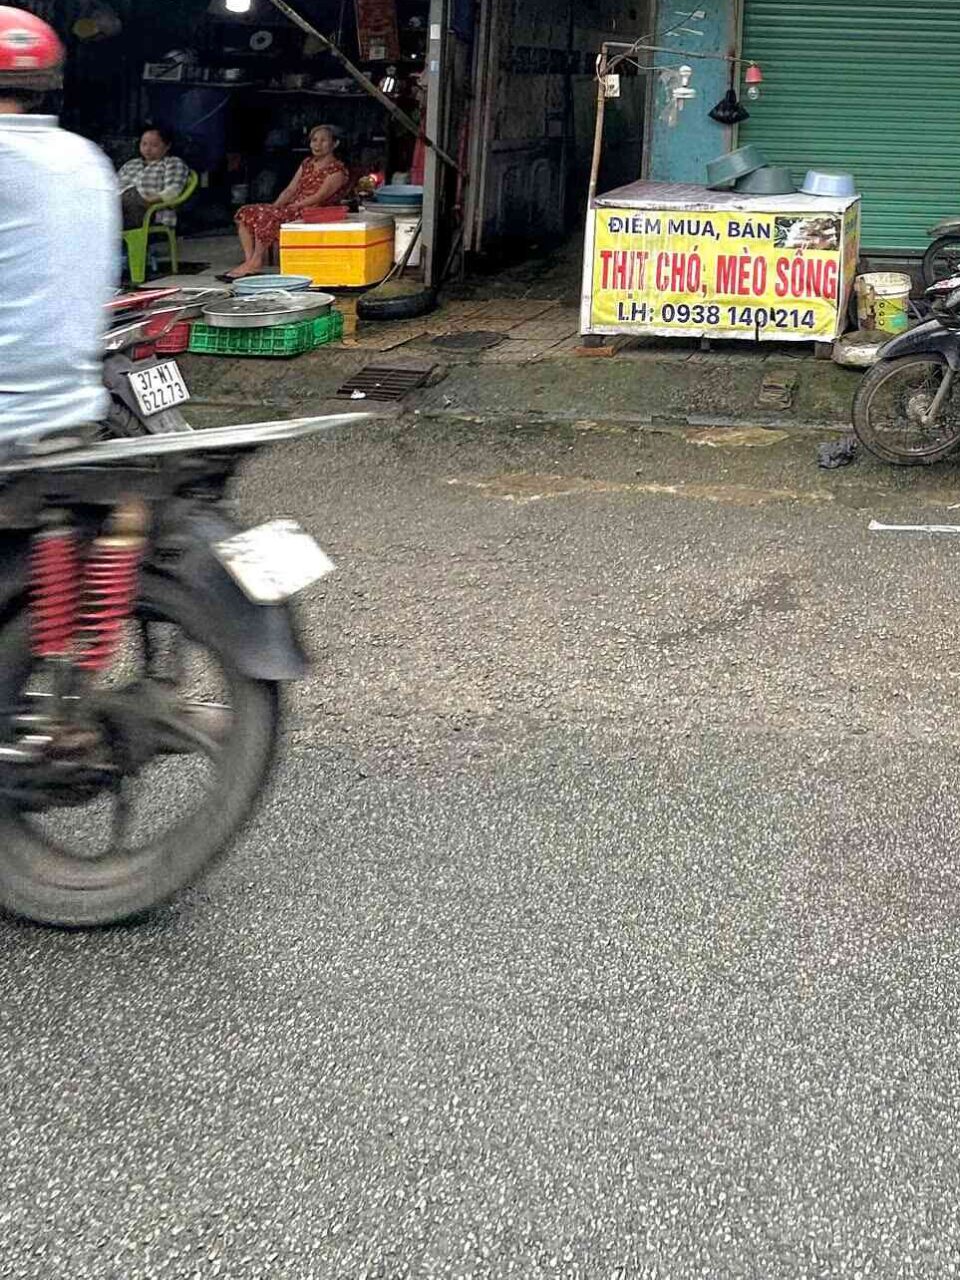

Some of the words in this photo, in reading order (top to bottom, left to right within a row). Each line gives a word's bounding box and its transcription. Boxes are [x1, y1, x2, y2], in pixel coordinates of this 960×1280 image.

[608, 211, 661, 235] ĐIỂM
[668, 219, 720, 240] MUA,
[727, 218, 771, 239] BÁN
[600, 250, 649, 299] THỊT
[655, 245, 707, 298] CHÓ,
[716, 247, 768, 297] MÈO
[775, 241, 837, 300] SỐNG
[618, 302, 654, 322] LH:
[661, 303, 720, 325] 0938
[728, 306, 768, 328] 140
[775, 308, 815, 329] 214
[137, 365, 173, 390] 37-N1
[142, 382, 184, 411] 622.73
